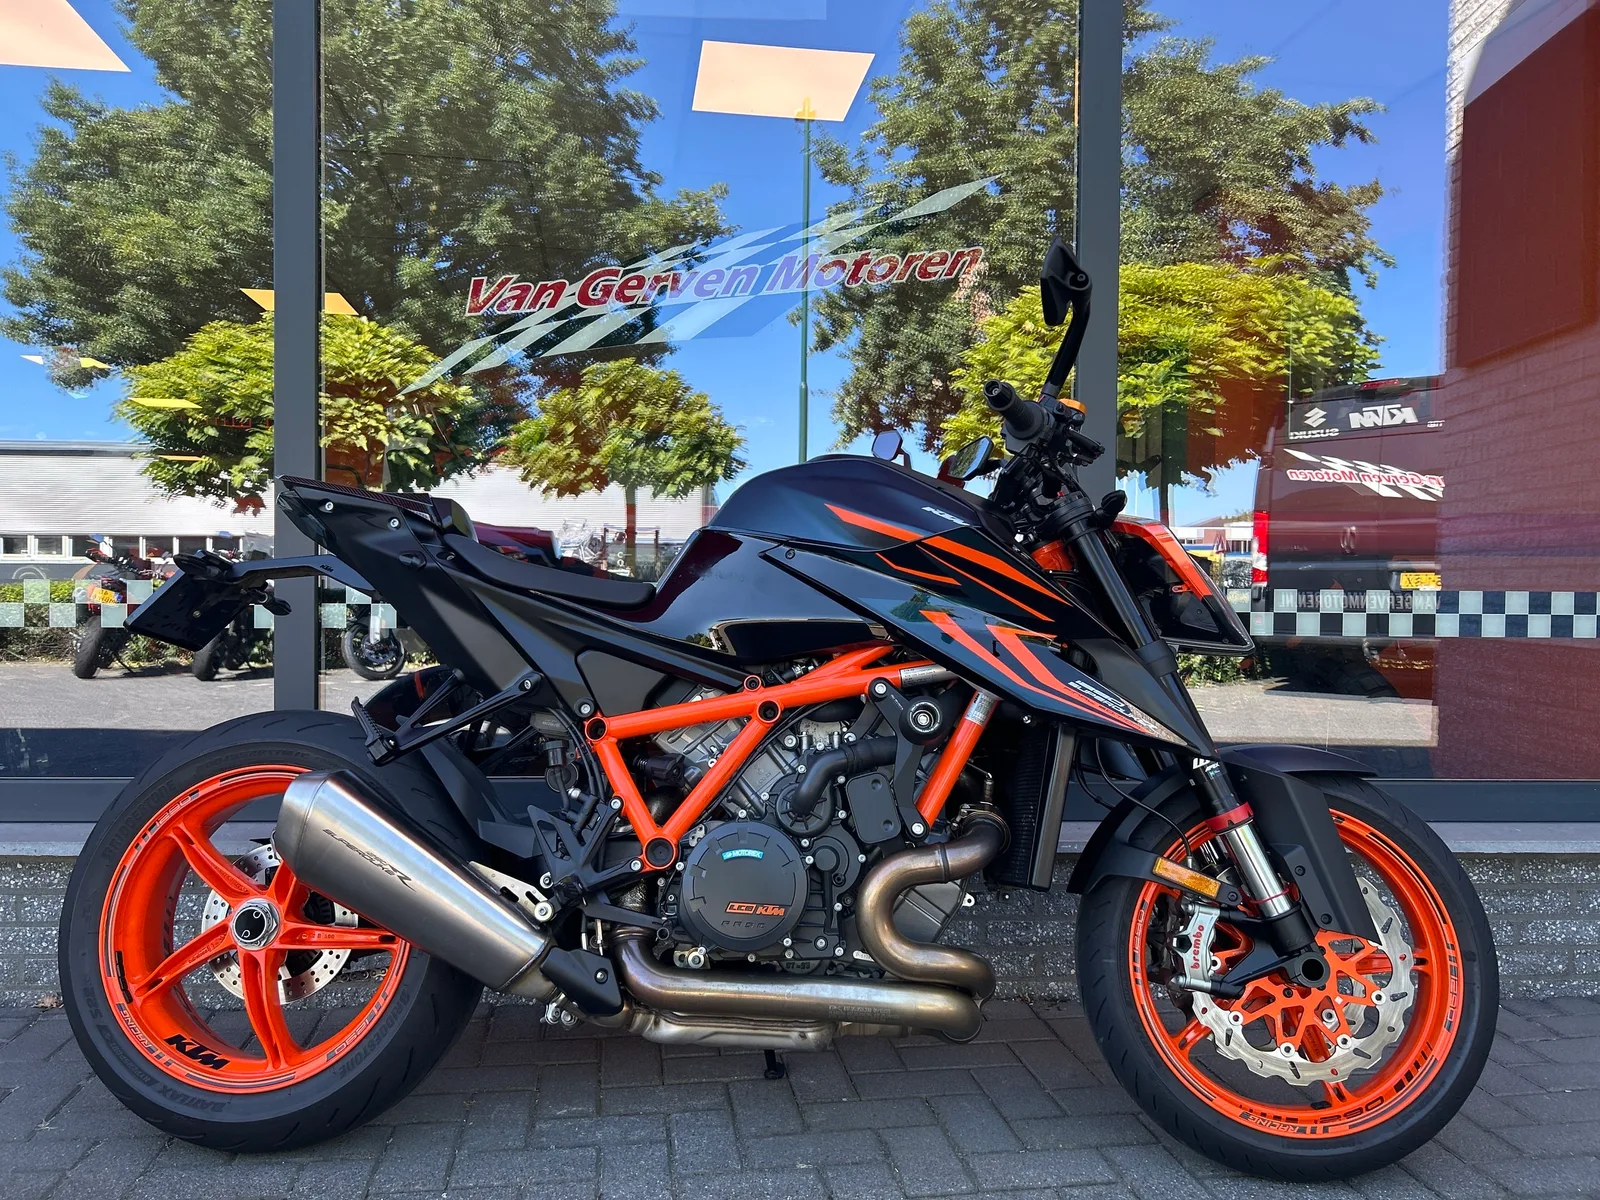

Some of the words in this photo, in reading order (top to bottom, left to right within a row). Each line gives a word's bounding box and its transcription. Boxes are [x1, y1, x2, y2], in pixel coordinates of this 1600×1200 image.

[465, 274, 569, 316] Van
[576, 265, 762, 308] Gerven
[764, 247, 985, 293] Motoren
[756, 904, 785, 916] KTM
[1190, 924, 1205, 970] brembo
[120, 1008, 154, 1049] RACING
[163, 1033, 231, 1071] KTM
[1248, 1114, 1300, 1134] RACING
